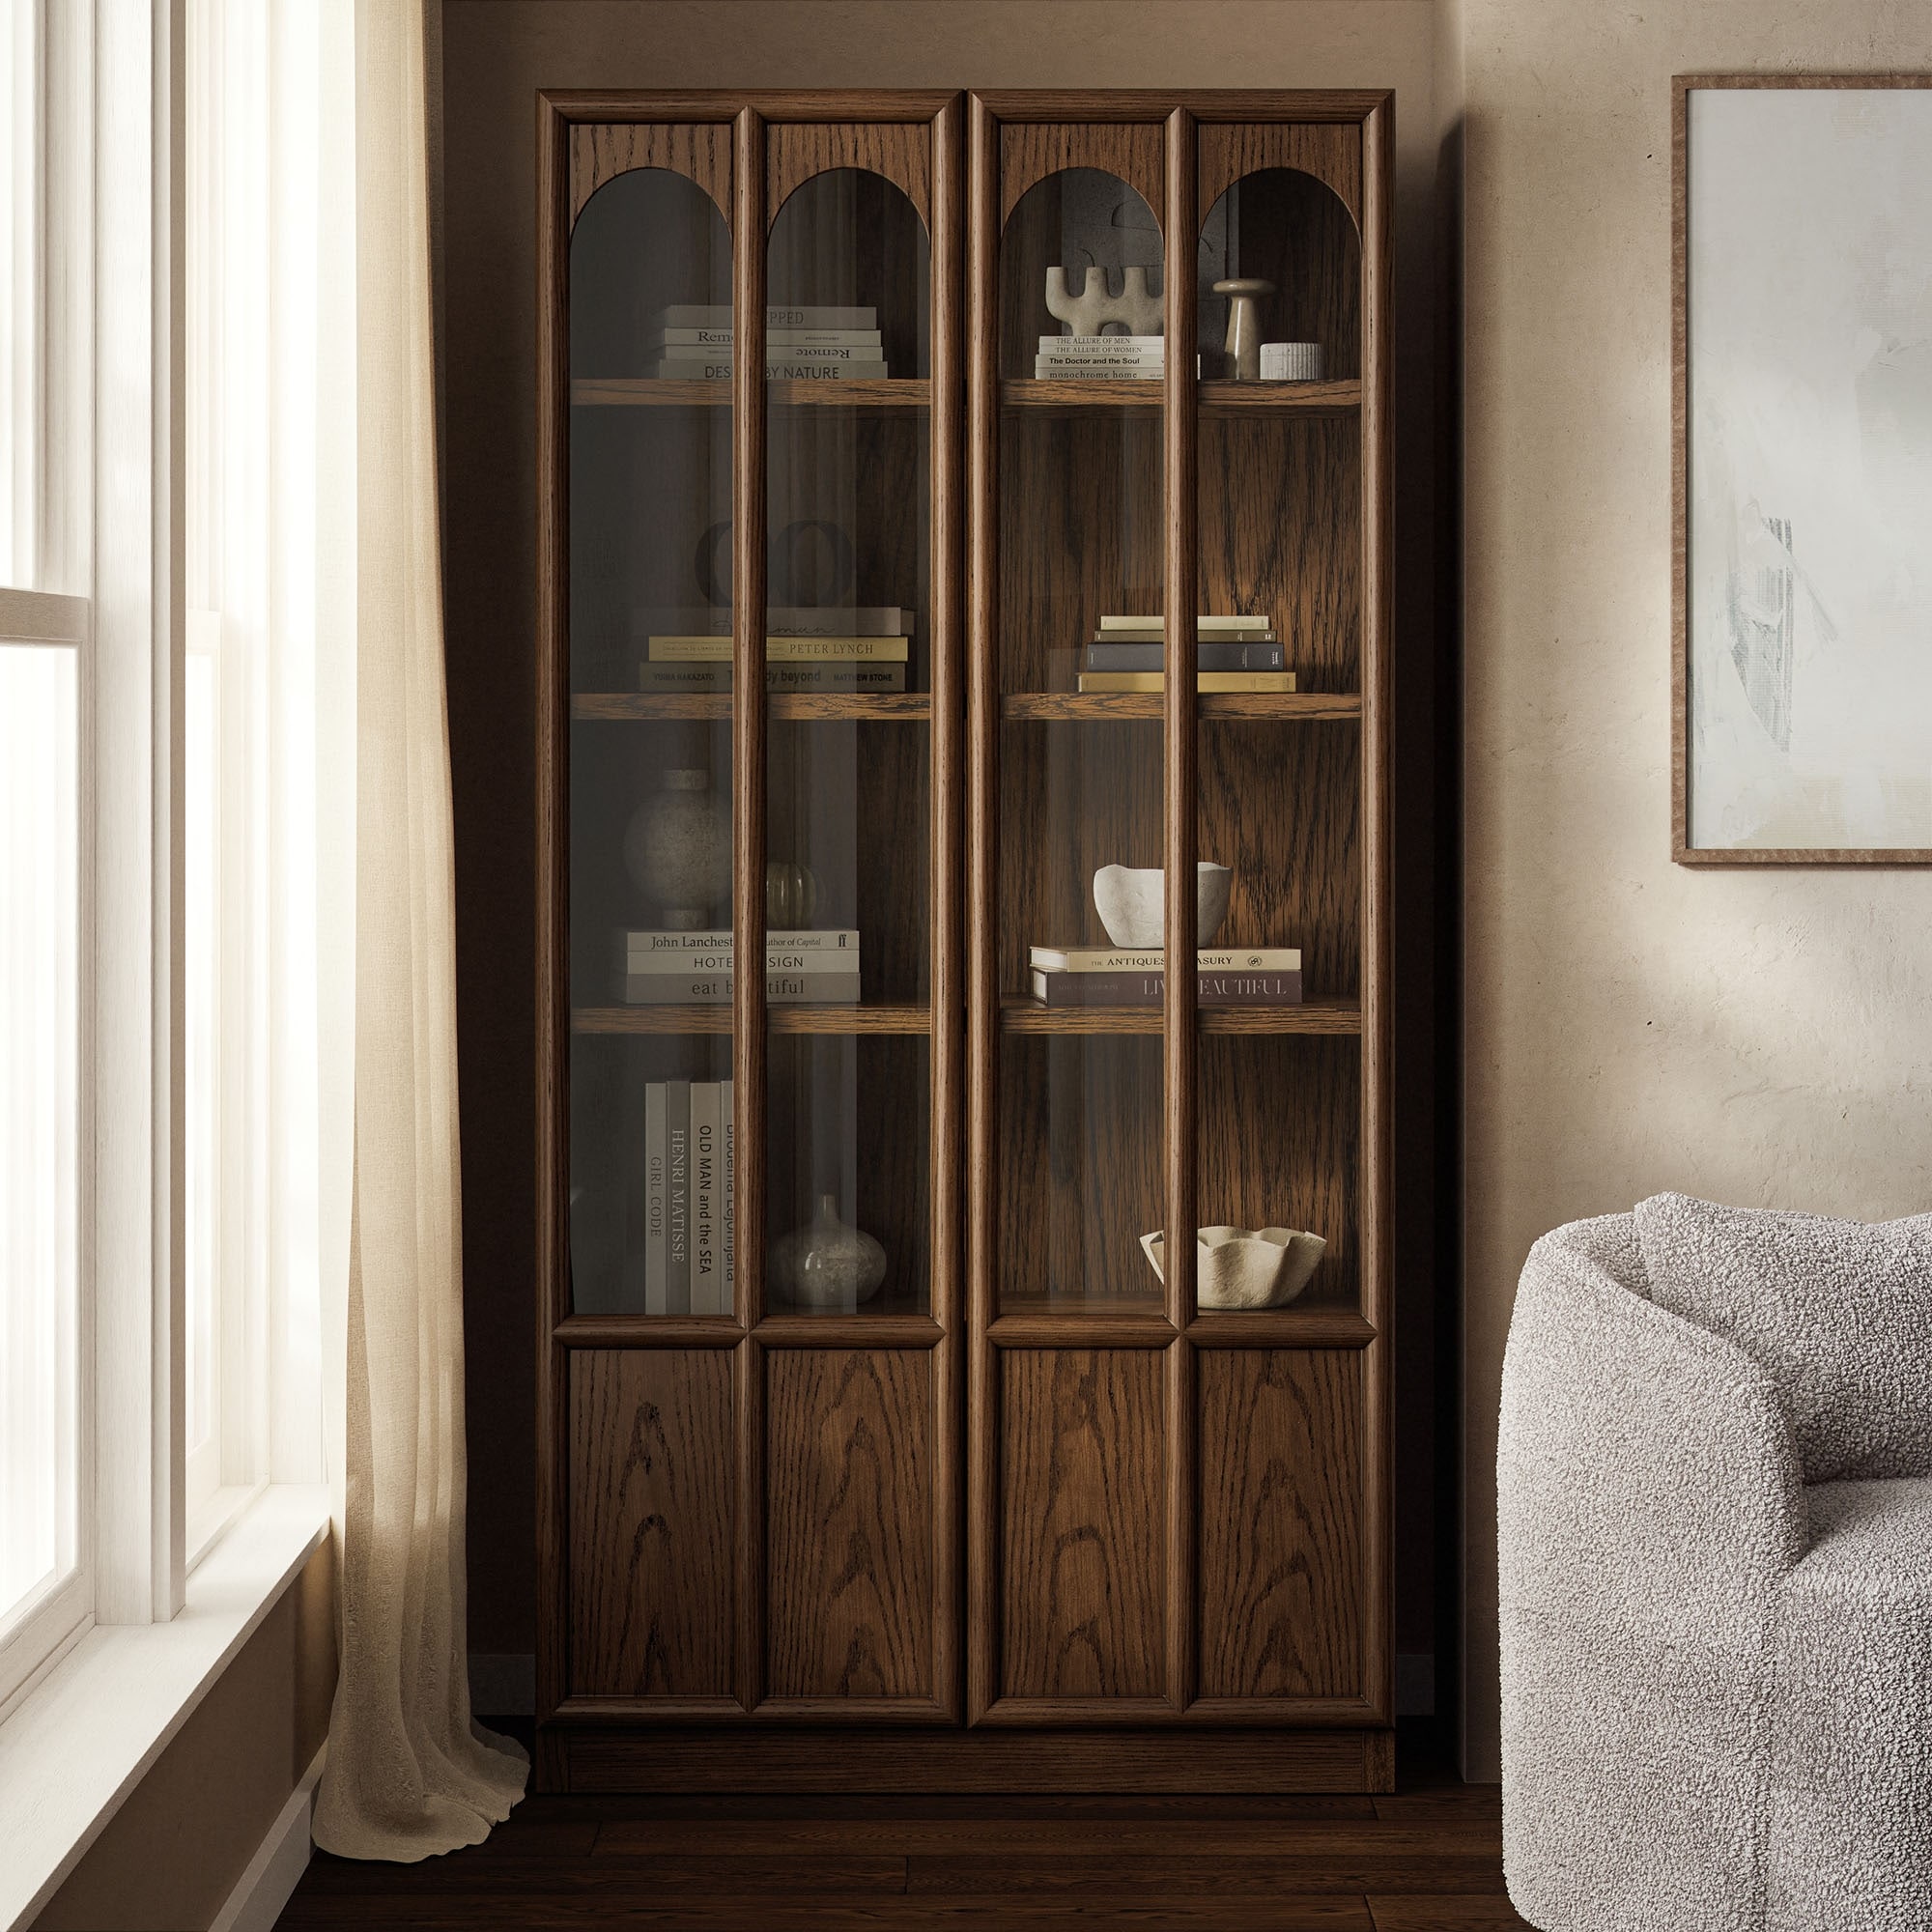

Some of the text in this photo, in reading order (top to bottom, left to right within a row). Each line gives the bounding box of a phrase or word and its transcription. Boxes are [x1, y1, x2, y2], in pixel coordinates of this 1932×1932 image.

[769, 311, 805, 325] PPED
[698, 331, 733, 342] Rem
[796, 349, 850, 359] Remote
[705, 366, 731, 379] DES
[783, 366, 840, 379] NATURE
[1049, 370, 1137, 379] monochrome home
[789, 643, 829, 654] PETER
[834, 643, 873, 654] LYNCH
[765, 670, 778, 684] dy
[781, 670, 820, 684] beyond
[651, 936, 821, 950] John Lanchest uthor of Capital
[694, 956, 804, 968] HOTE SIGN
[1197, 956, 1233, 965] ASURY
[692, 981, 719, 995] eat
[1199, 979, 1288, 995] EAUTIFUL
[650, 1156, 662, 1238] GIRL CODE
[671, 1129, 685, 1263] HENRI MATISSE
[698, 1124, 713, 1275] OLD MAN and the SEA
